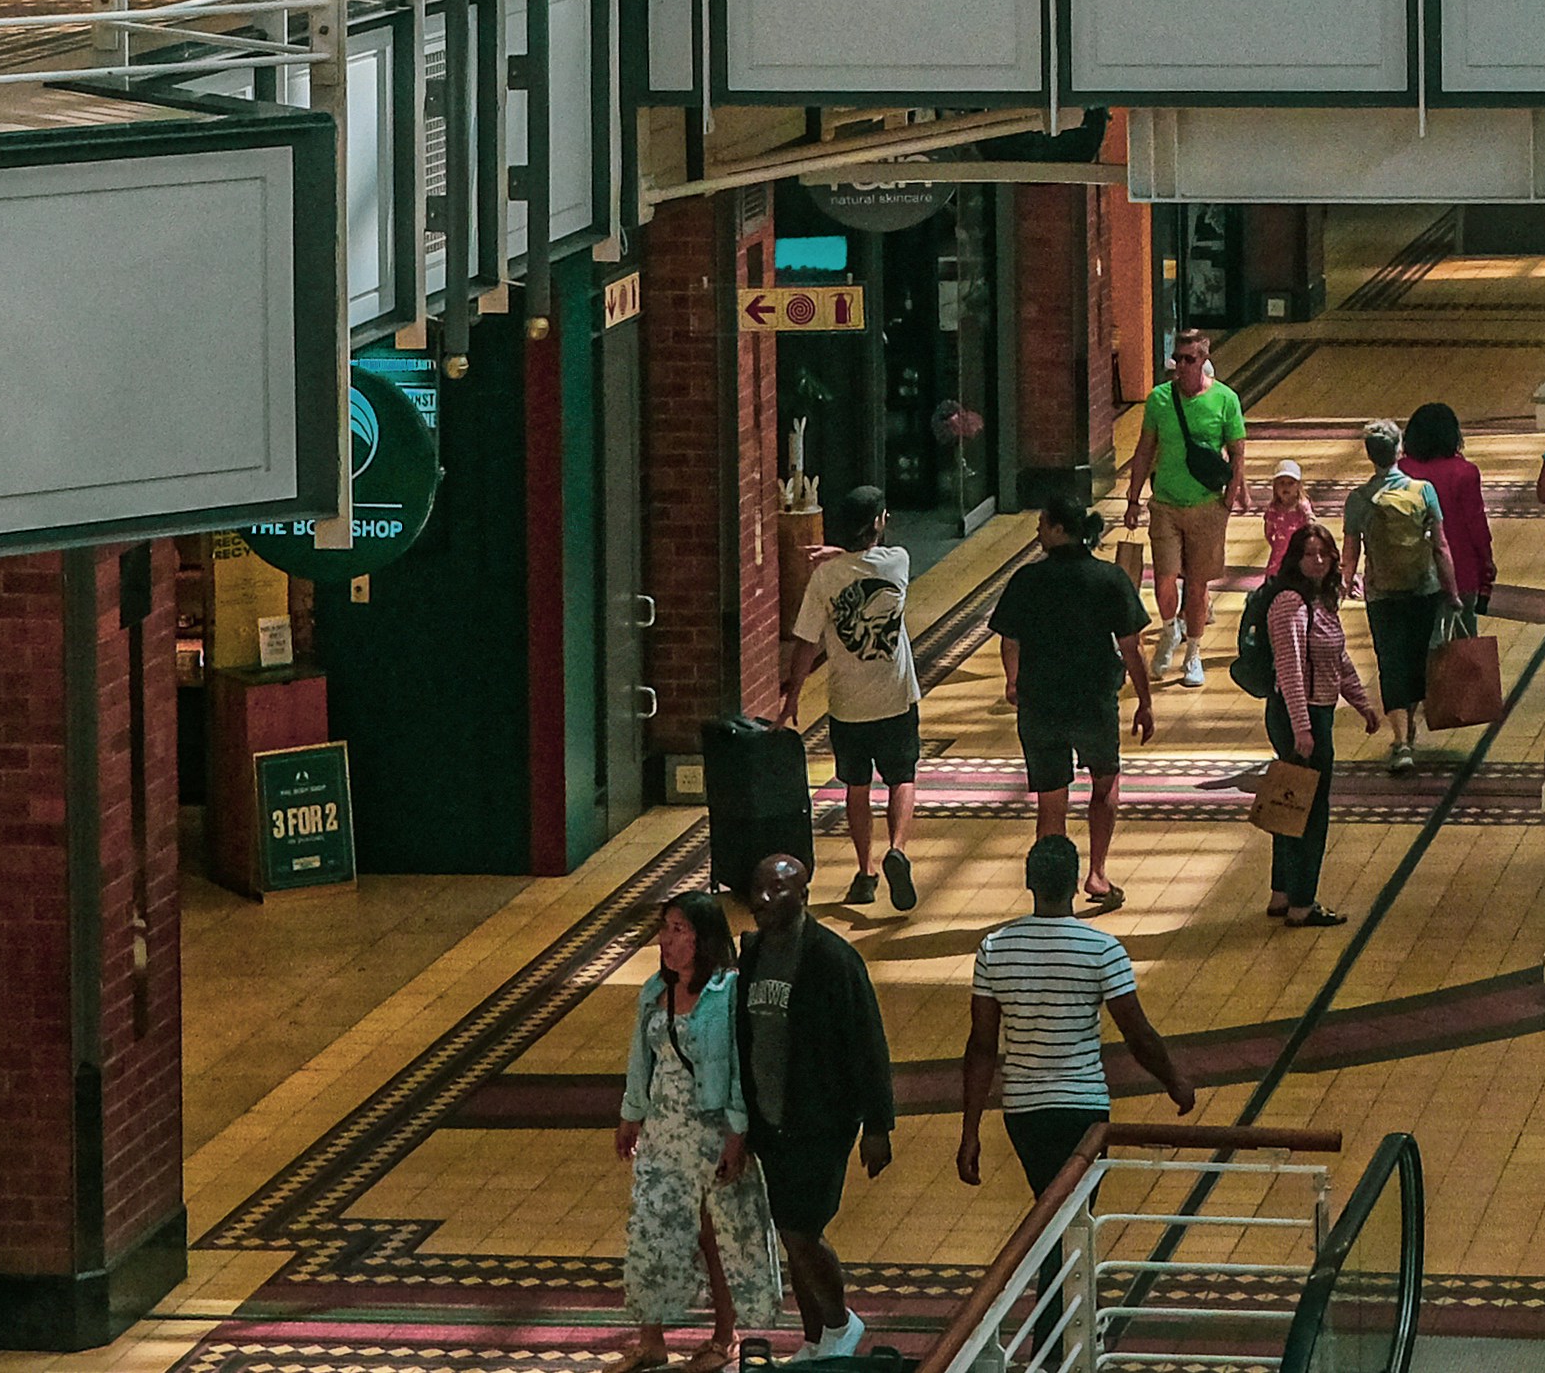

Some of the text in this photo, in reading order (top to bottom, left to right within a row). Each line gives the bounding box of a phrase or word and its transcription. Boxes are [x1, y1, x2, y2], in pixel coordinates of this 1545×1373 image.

[830, 192, 934, 206] natural skincare
[352, 519, 403, 538] SHOP
[272, 802, 339, 839] 3 FOR 2
